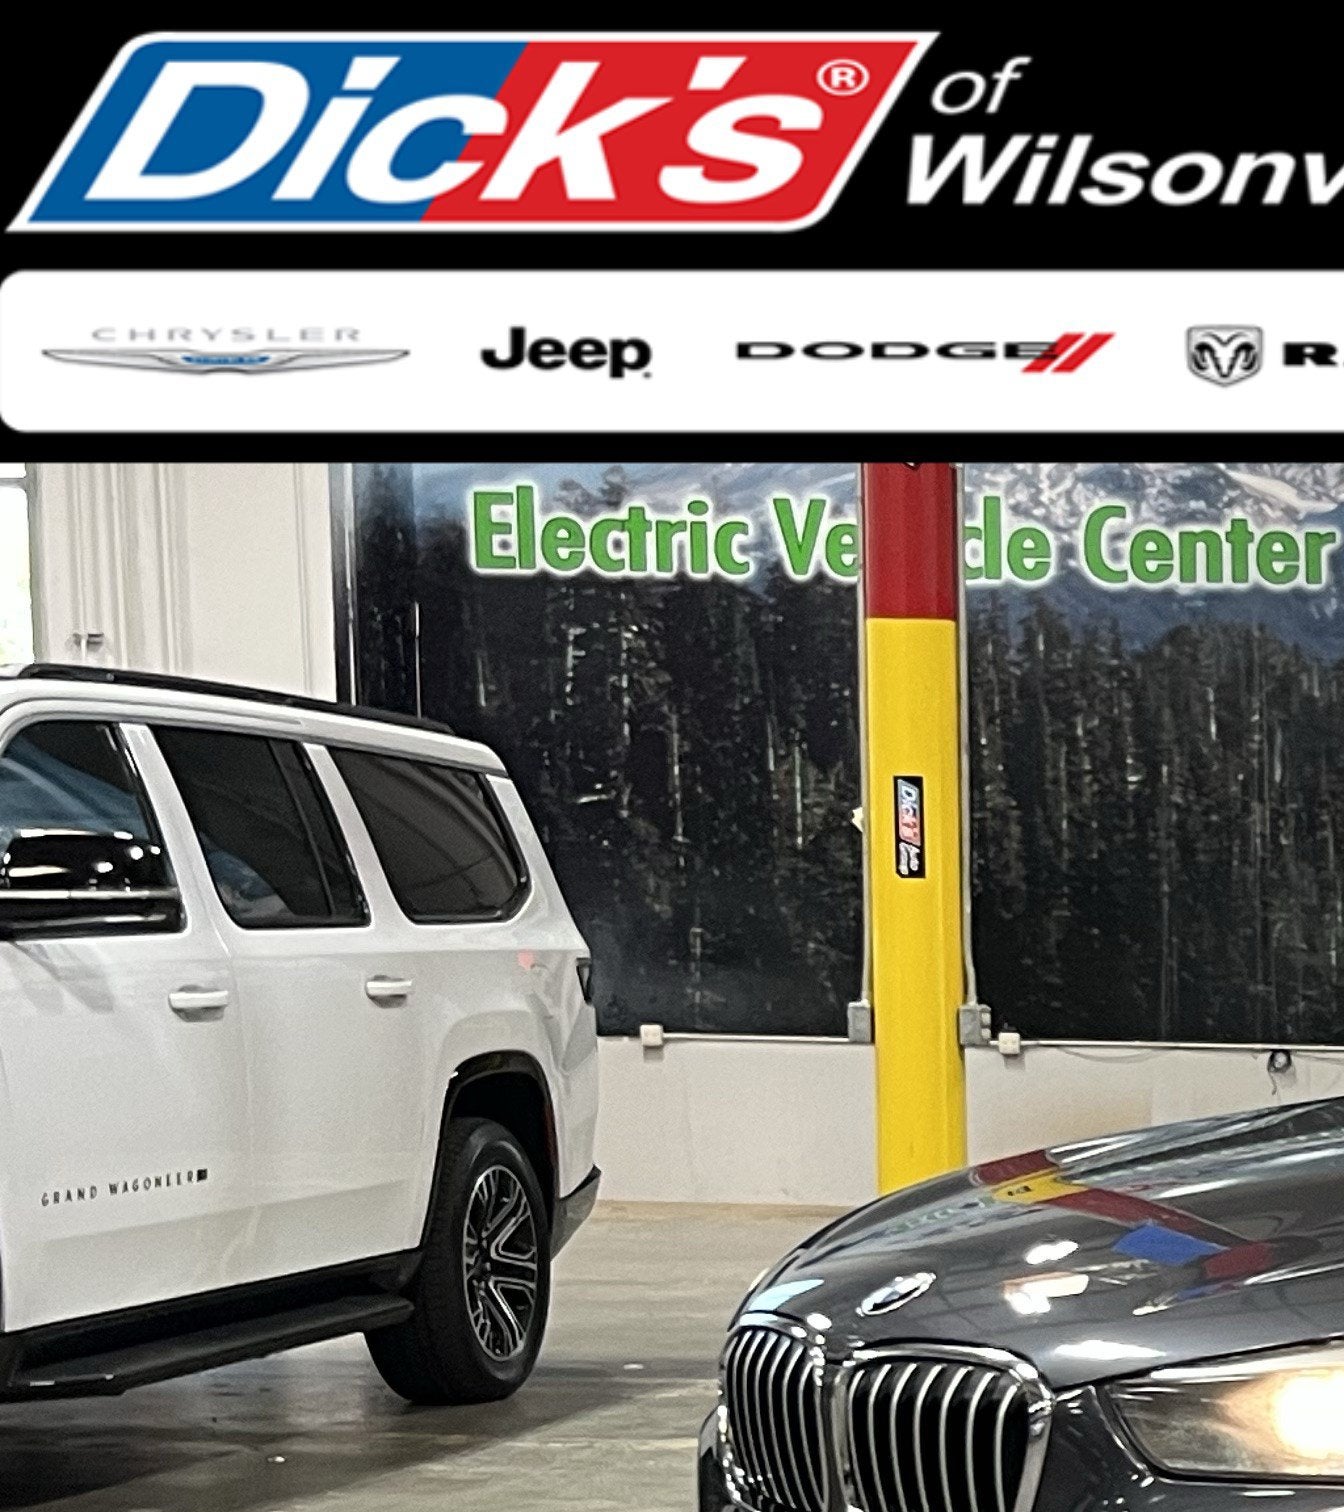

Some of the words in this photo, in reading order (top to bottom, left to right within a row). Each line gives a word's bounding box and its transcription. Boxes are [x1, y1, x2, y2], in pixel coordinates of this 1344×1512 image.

[473, 485, 751, 576] Electric
[773, 495, 1051, 581] Vele
[1084, 504, 1337, 585] Center
[40, 1184, 98, 1207] GRAND
